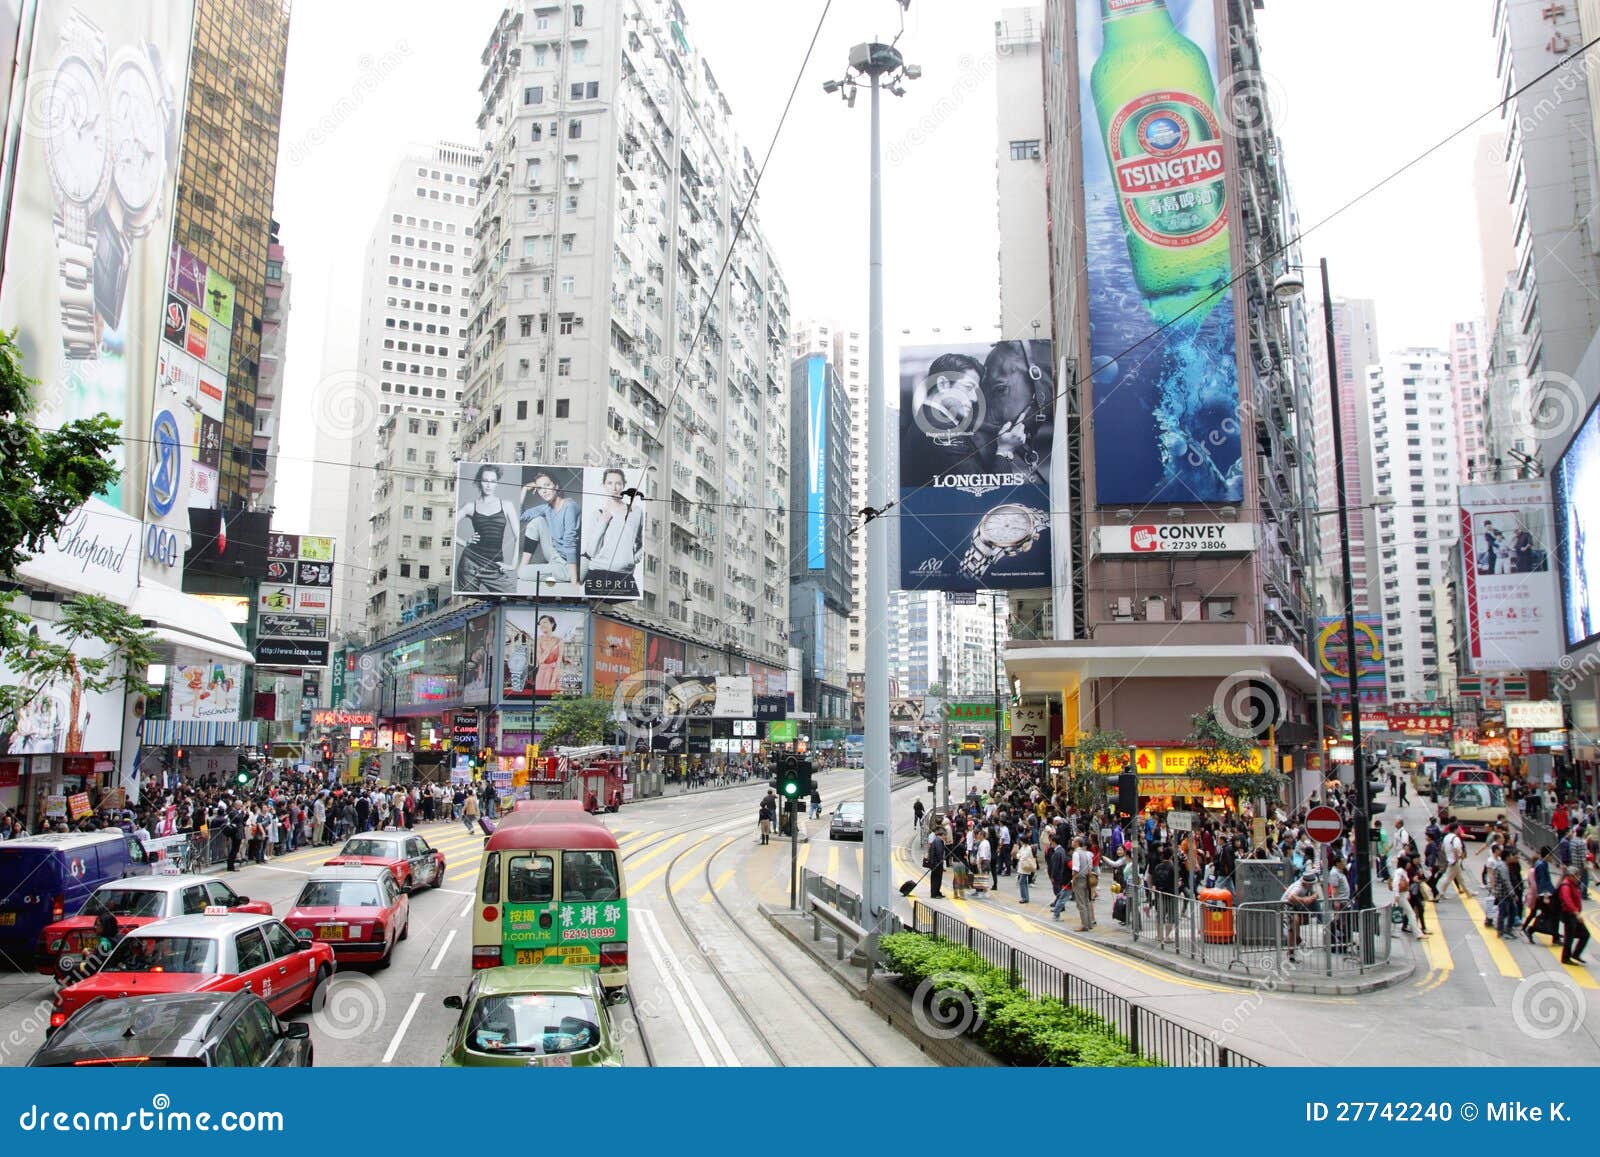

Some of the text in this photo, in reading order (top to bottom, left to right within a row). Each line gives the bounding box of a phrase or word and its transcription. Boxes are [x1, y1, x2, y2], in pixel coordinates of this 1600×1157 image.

[1121, 149, 1222, 188] TSINGTAO
[933, 472, 1025, 488] LONGINES
[1159, 526, 1225, 539] CONVEY
[56, 508, 132, 574] Chopard
[1172, 541, 1227, 550] 2739 3806
[586, 579, 635, 588] ESPRIT
[1165, 757, 1185, 766] BEE
[591, 928, 615, 938] 9999
